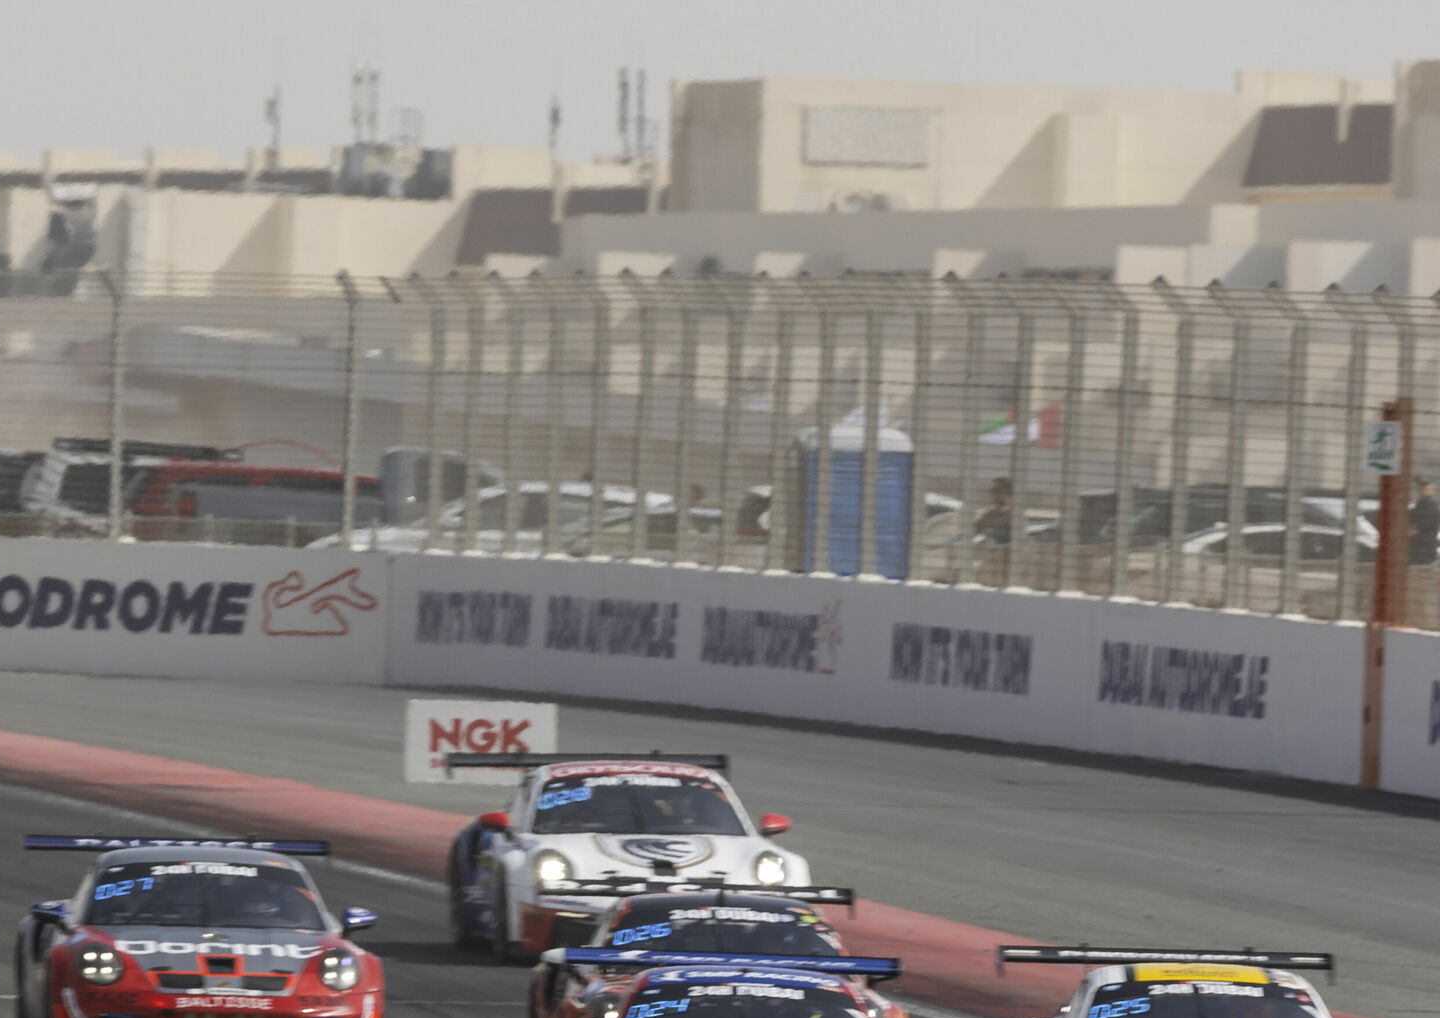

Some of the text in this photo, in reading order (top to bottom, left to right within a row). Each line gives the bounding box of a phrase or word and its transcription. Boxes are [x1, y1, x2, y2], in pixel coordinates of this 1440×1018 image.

[429, 717, 532, 754] NGK
[93, 877, 155, 900] 027
[613, 921, 673, 947] 026
[114, 939, 324, 959] Dorint
